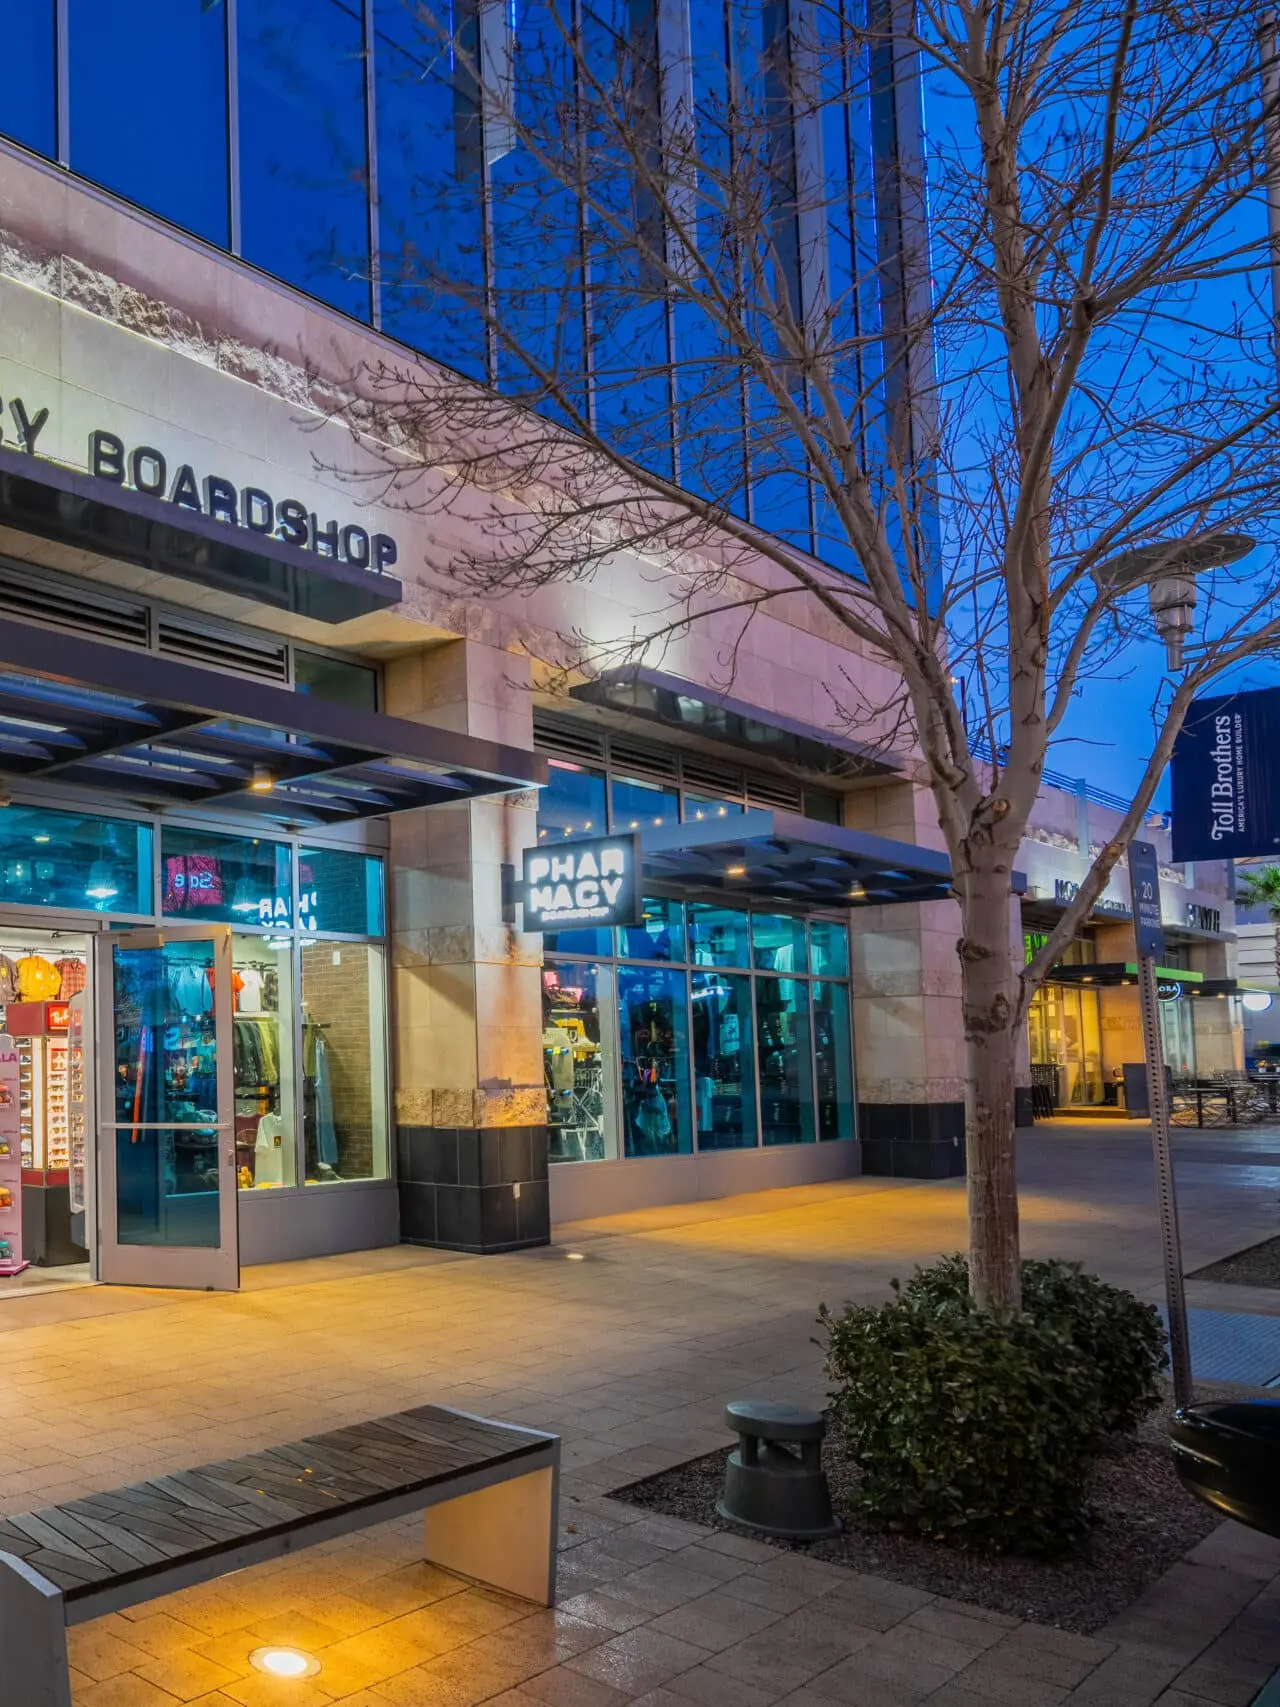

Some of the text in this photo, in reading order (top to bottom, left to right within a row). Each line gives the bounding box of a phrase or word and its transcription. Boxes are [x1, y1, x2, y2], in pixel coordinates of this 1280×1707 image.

[87, 429, 397, 574] BOARDSHOP
[1235, 745, 1244, 765] HOME
[1209, 715, 1234, 841] Toll Brothers
[530, 848, 624, 885] PHAR
[530, 878, 623, 913] MACY
[1142, 881, 1153, 900] 20
